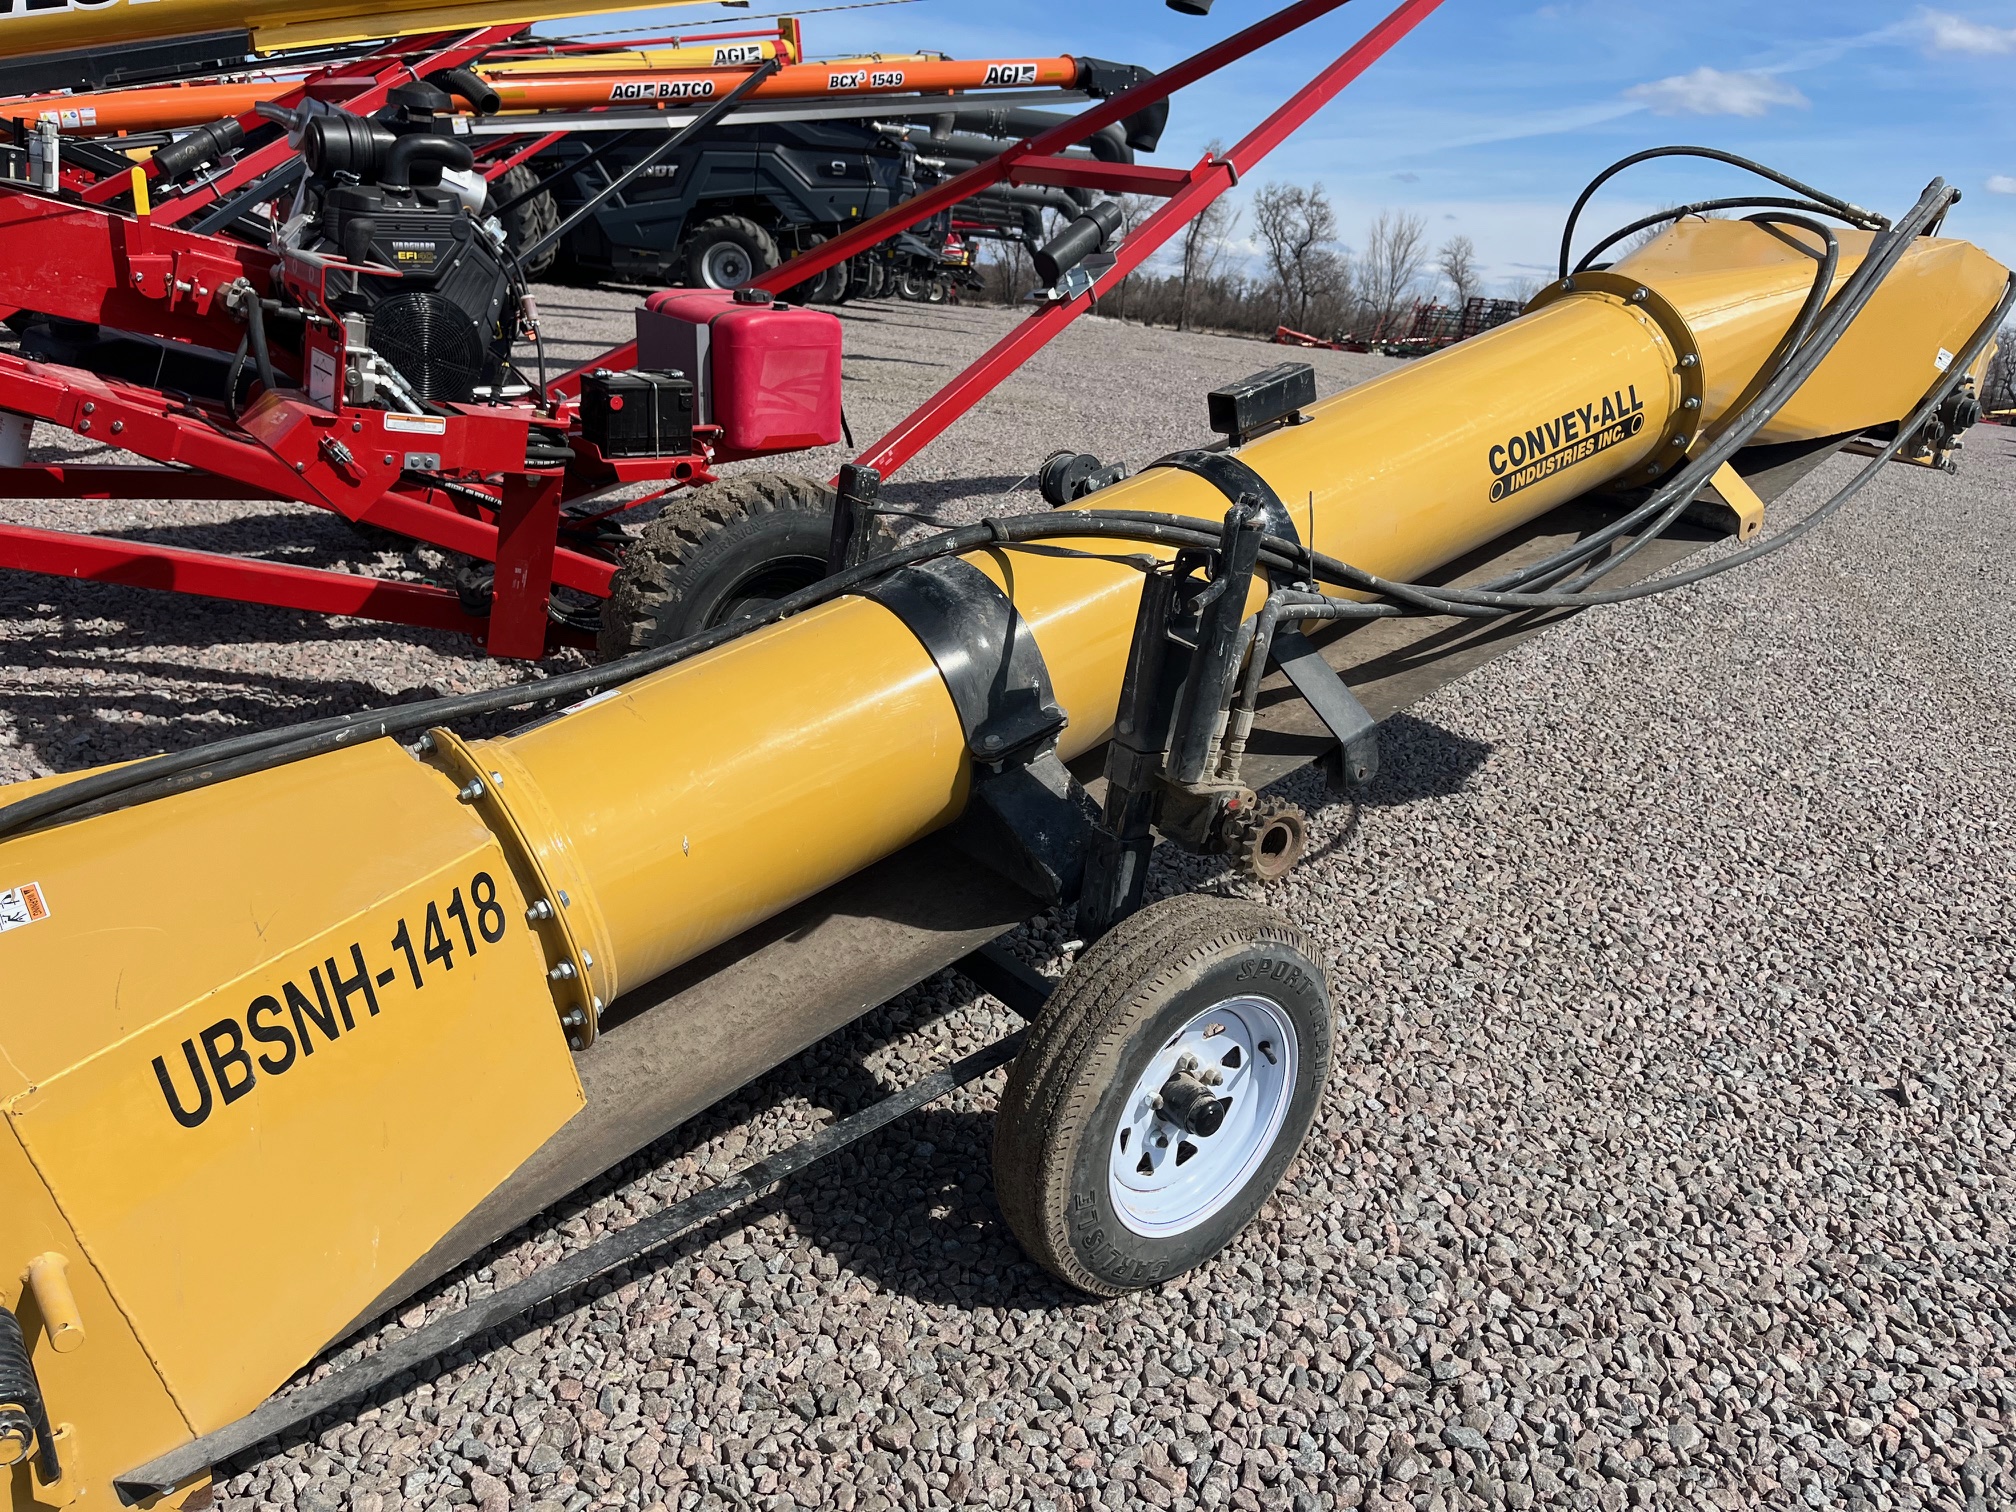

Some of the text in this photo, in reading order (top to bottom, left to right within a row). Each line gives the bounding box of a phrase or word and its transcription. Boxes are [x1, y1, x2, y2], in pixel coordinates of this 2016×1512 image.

[714, 48, 745, 65] AGI
[871, 73, 903, 87] 1549
[984, 66, 1019, 85] AGI
[612, 82, 713, 99] AGI BATCO
[392, 241, 436, 251] VANGUARD
[1489, 385, 1643, 475] CONVEY-ALL
[1510, 426, 1625, 492] INDUSTRIES INC.
[27, 892, 43, 917] WARNING
[151, 871, 506, 1128] UBSNH-1418
[1236, 958, 1330, 1092] SPORT TRAIL
[1074, 1189, 1170, 1282] CARLISLE
